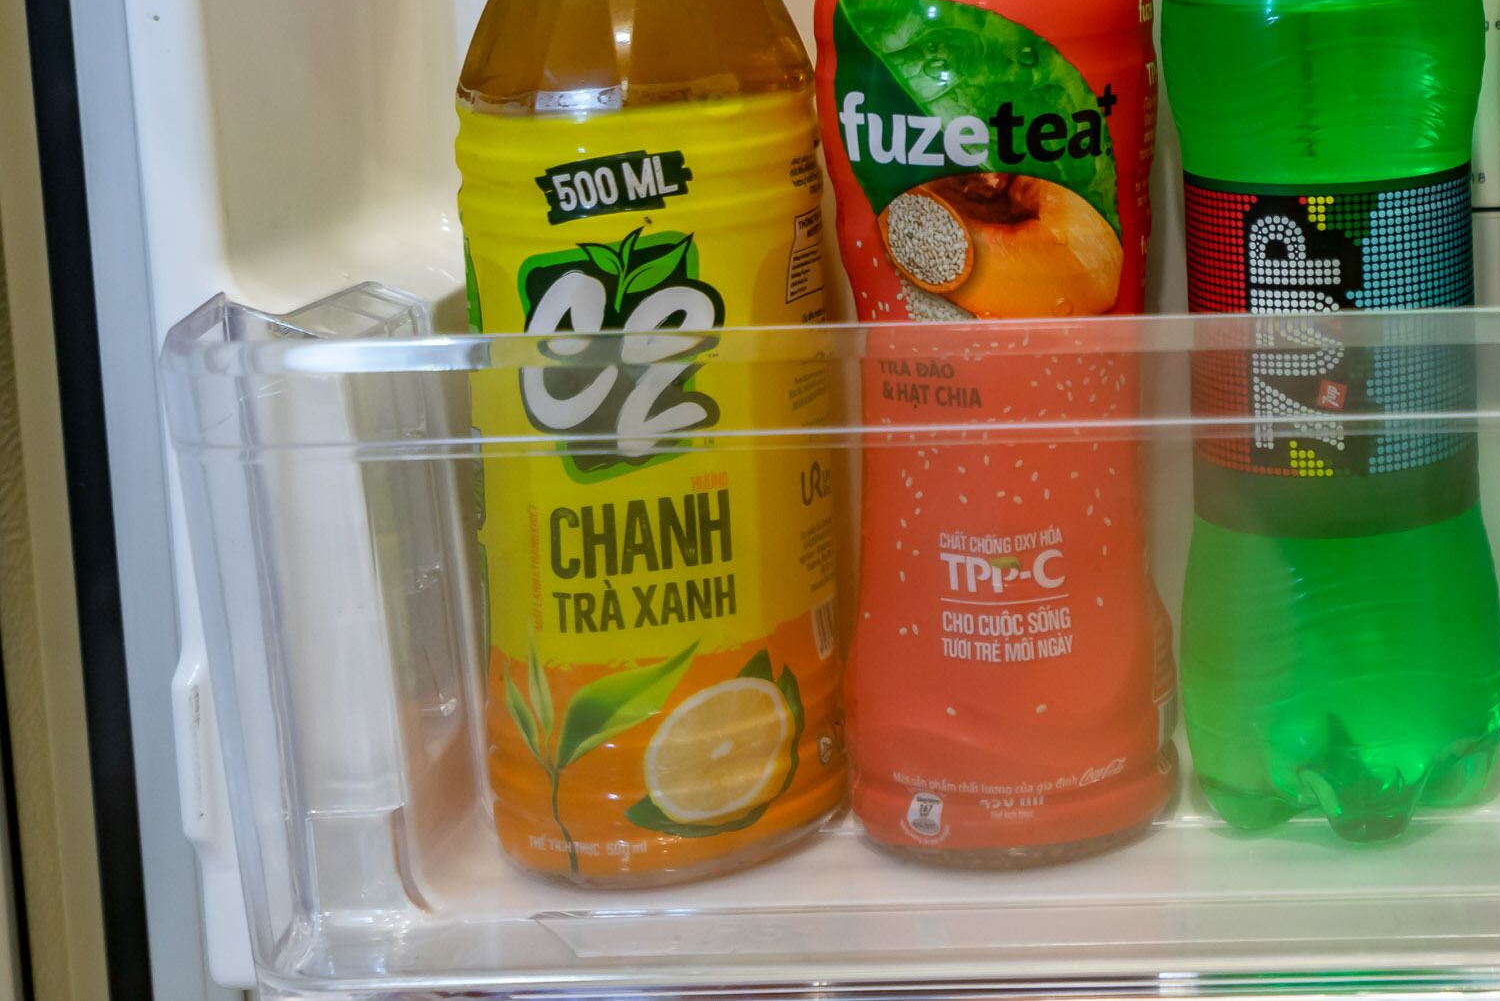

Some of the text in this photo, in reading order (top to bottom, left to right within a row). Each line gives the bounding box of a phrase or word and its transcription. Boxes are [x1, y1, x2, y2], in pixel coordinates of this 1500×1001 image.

[552, 156, 678, 211] 500 ML
[520, 269, 714, 457] C2
[916, 358, 955, 379] ĐÀO
[883, 381, 983, 409] & HẠT CHIA
[550, 489, 732, 579] CHANH
[940, 524, 1063, 554] CHẤT CHỐNG OXY HÓA
[552, 574, 737, 633] TRÀ XANH
[942, 605, 1071, 640] CHO CUỘC SỐNG
[941, 637, 971, 659] TƯƠI
[1005, 637, 1034, 662] MỖI
[1038, 632, 1073, 658] NGÀY
[959, 779, 978, 793] chất
[1036, 781, 1053, 795] gia
[1055, 775, 1078, 790] đình
